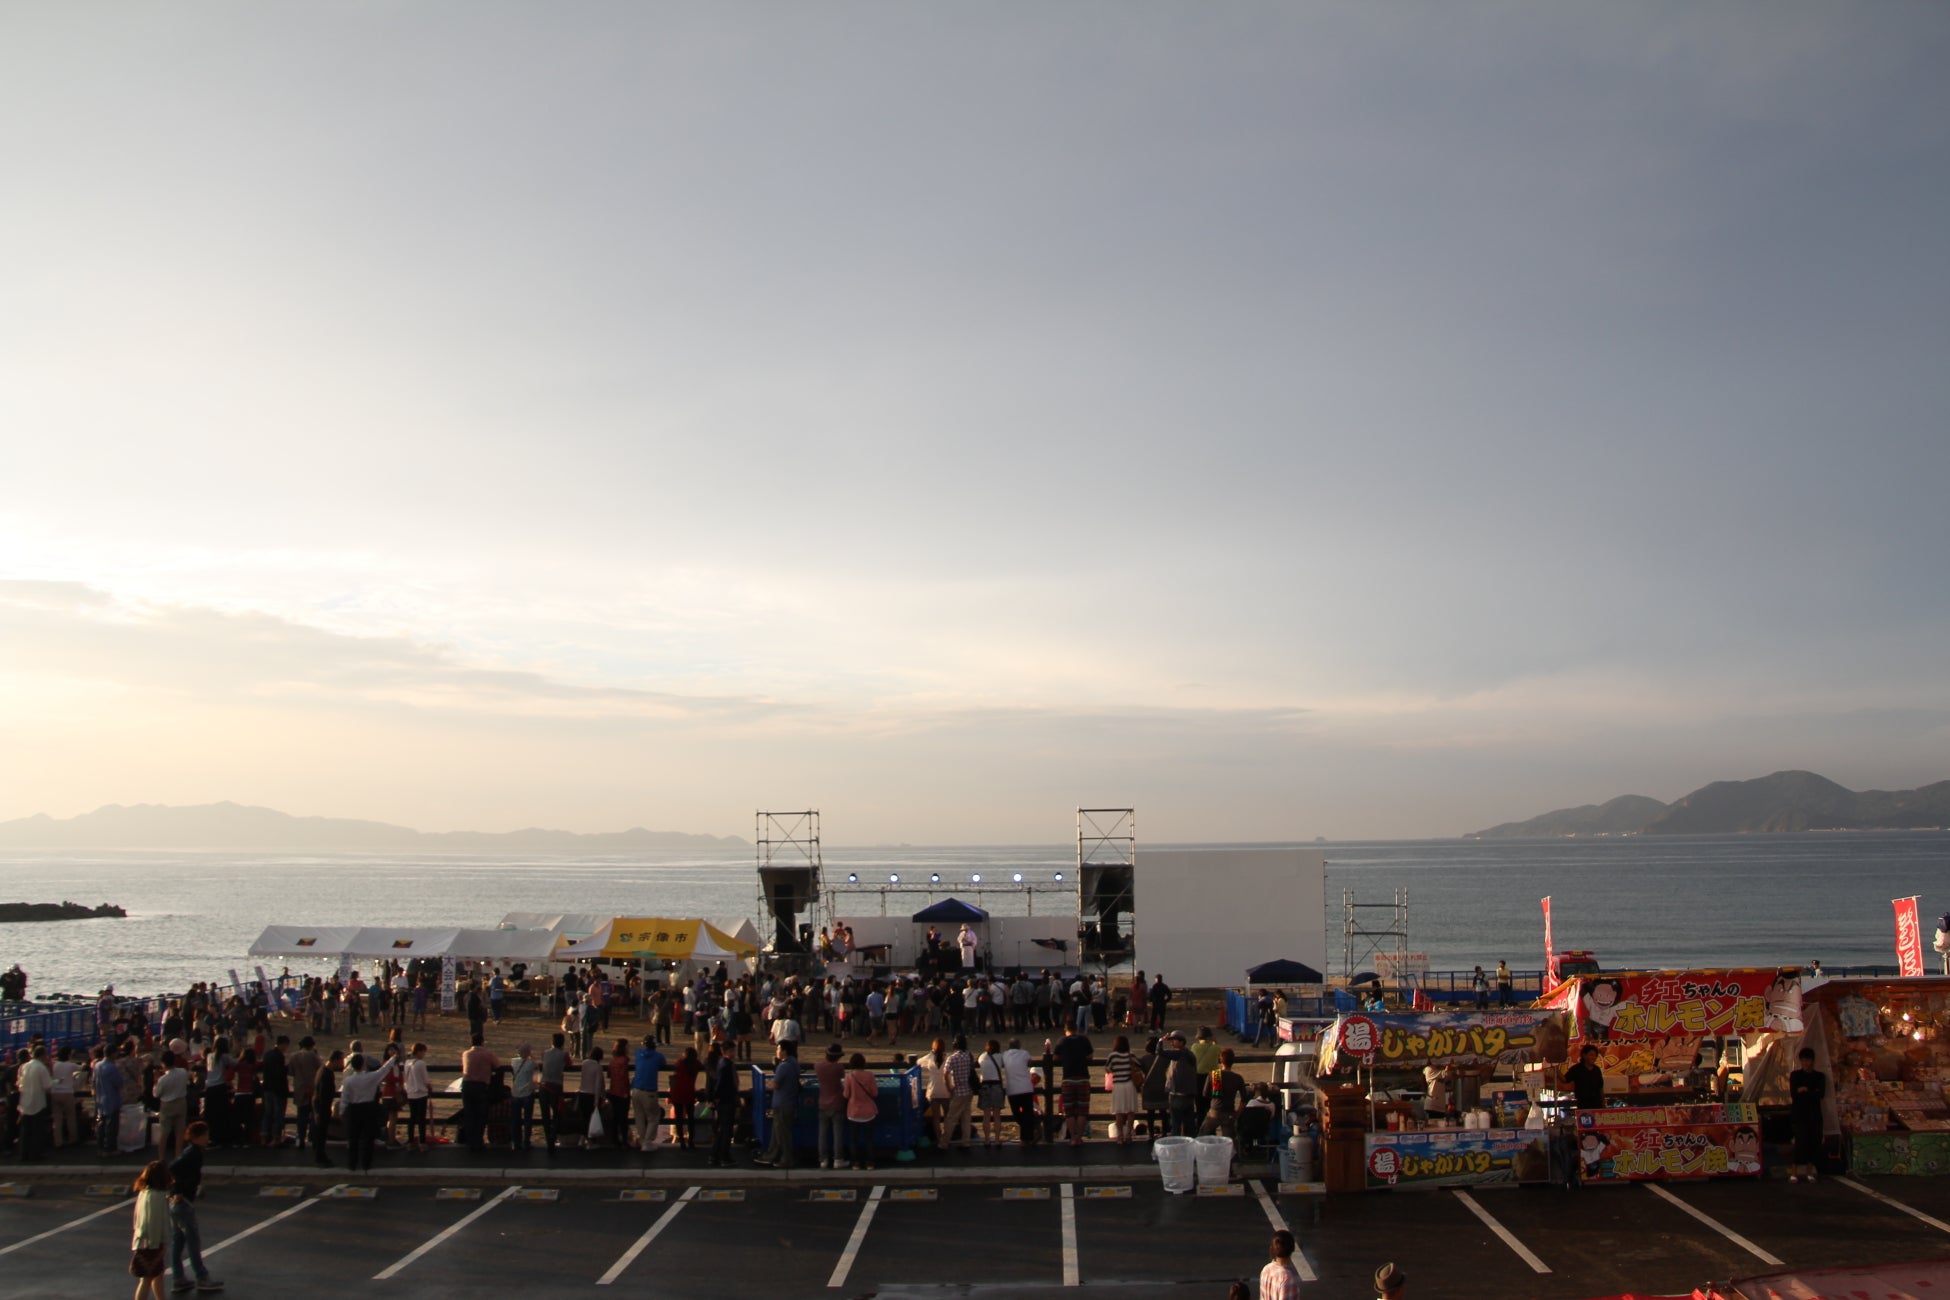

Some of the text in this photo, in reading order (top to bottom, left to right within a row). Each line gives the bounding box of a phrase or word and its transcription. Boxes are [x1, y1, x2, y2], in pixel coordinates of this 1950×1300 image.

[638, 931, 688, 943] 宗像市
[443, 956, 455, 1008] 大会本部
[1614, 996, 1765, 1034] ホルモン焼
[1382, 1027, 1535, 1060] じゃがバター
[1402, 1151, 1511, 1177] じゃがバター
[1613, 1147, 1730, 1176] ホルモン焼
